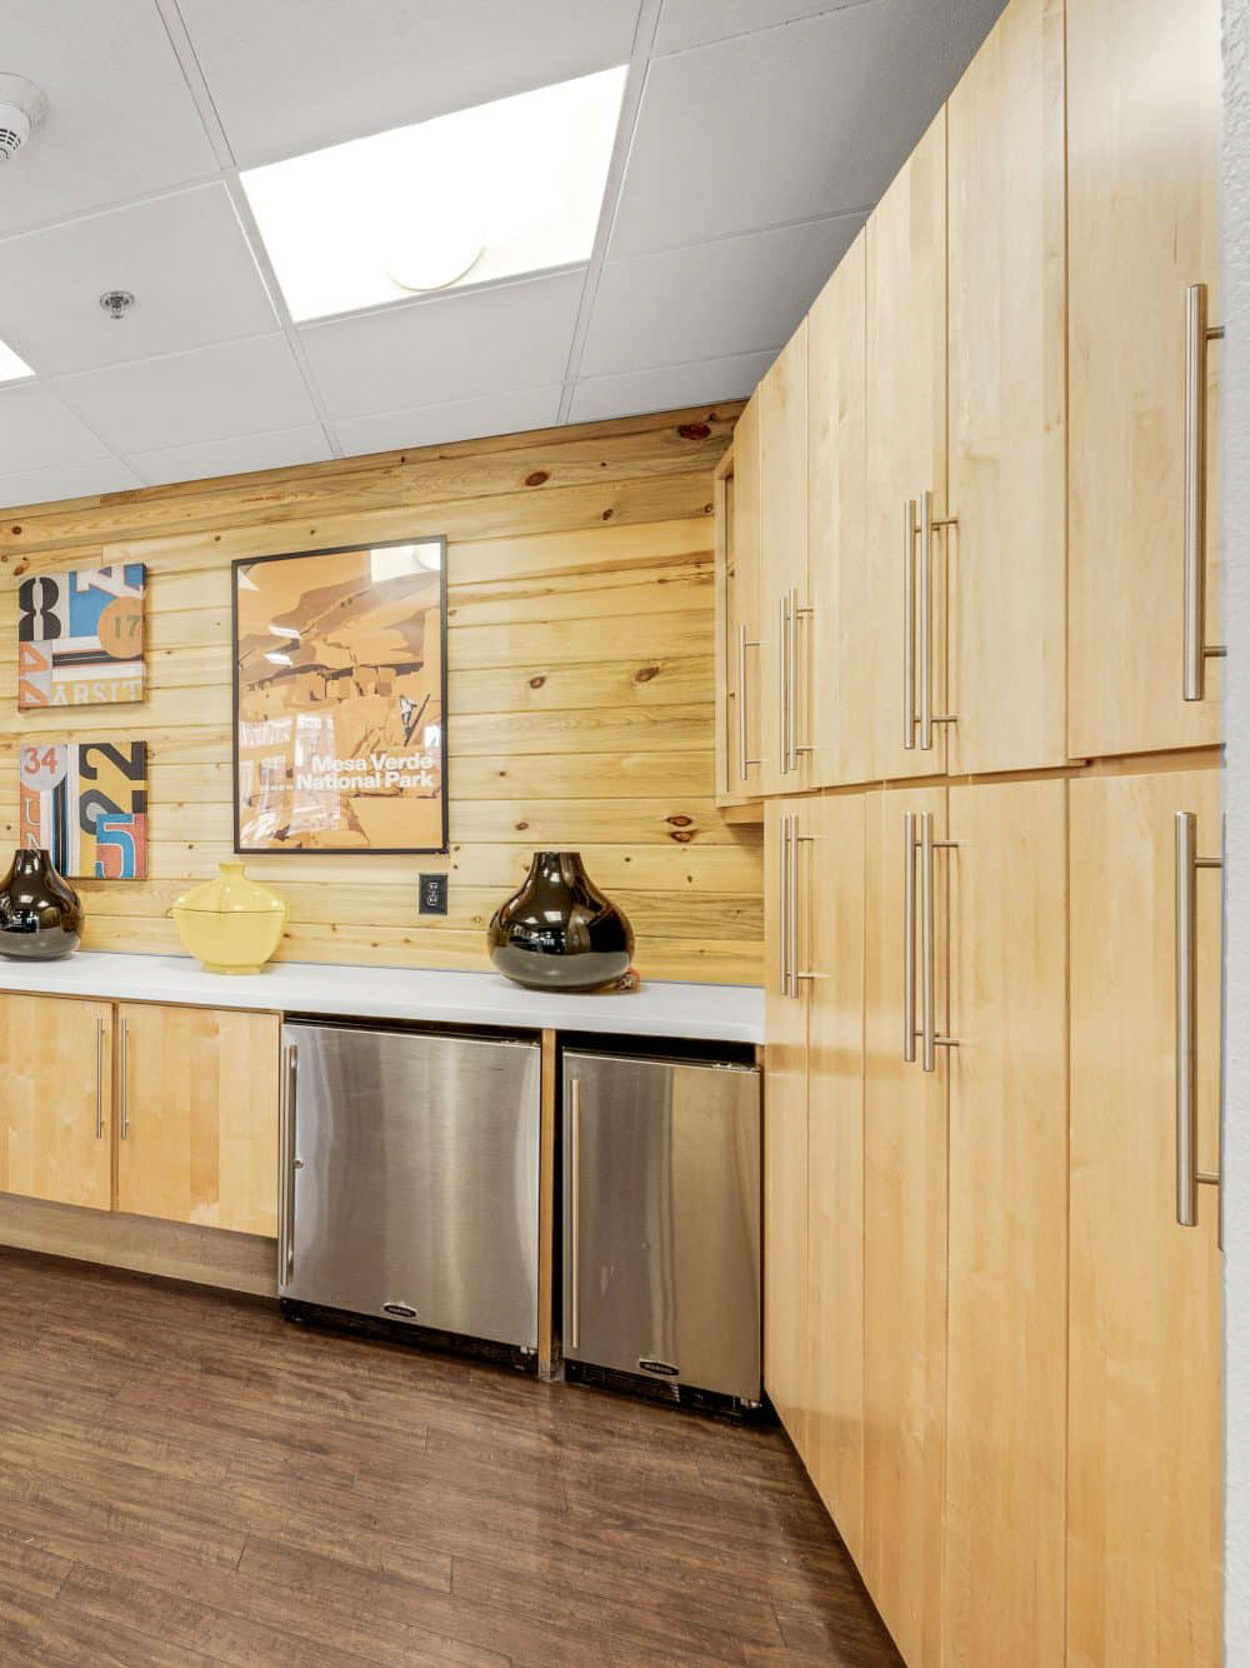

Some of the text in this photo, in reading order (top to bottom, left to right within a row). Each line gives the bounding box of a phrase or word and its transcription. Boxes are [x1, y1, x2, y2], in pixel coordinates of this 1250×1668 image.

[18, 577, 61, 641] 8
[114, 614, 142, 640] 17
[24, 747, 58, 775] 34
[312, 752, 433, 773] Mesa Verde
[297, 772, 381, 790] National
[385, 771, 434, 789] Park
[96, 813, 136, 878] 5
